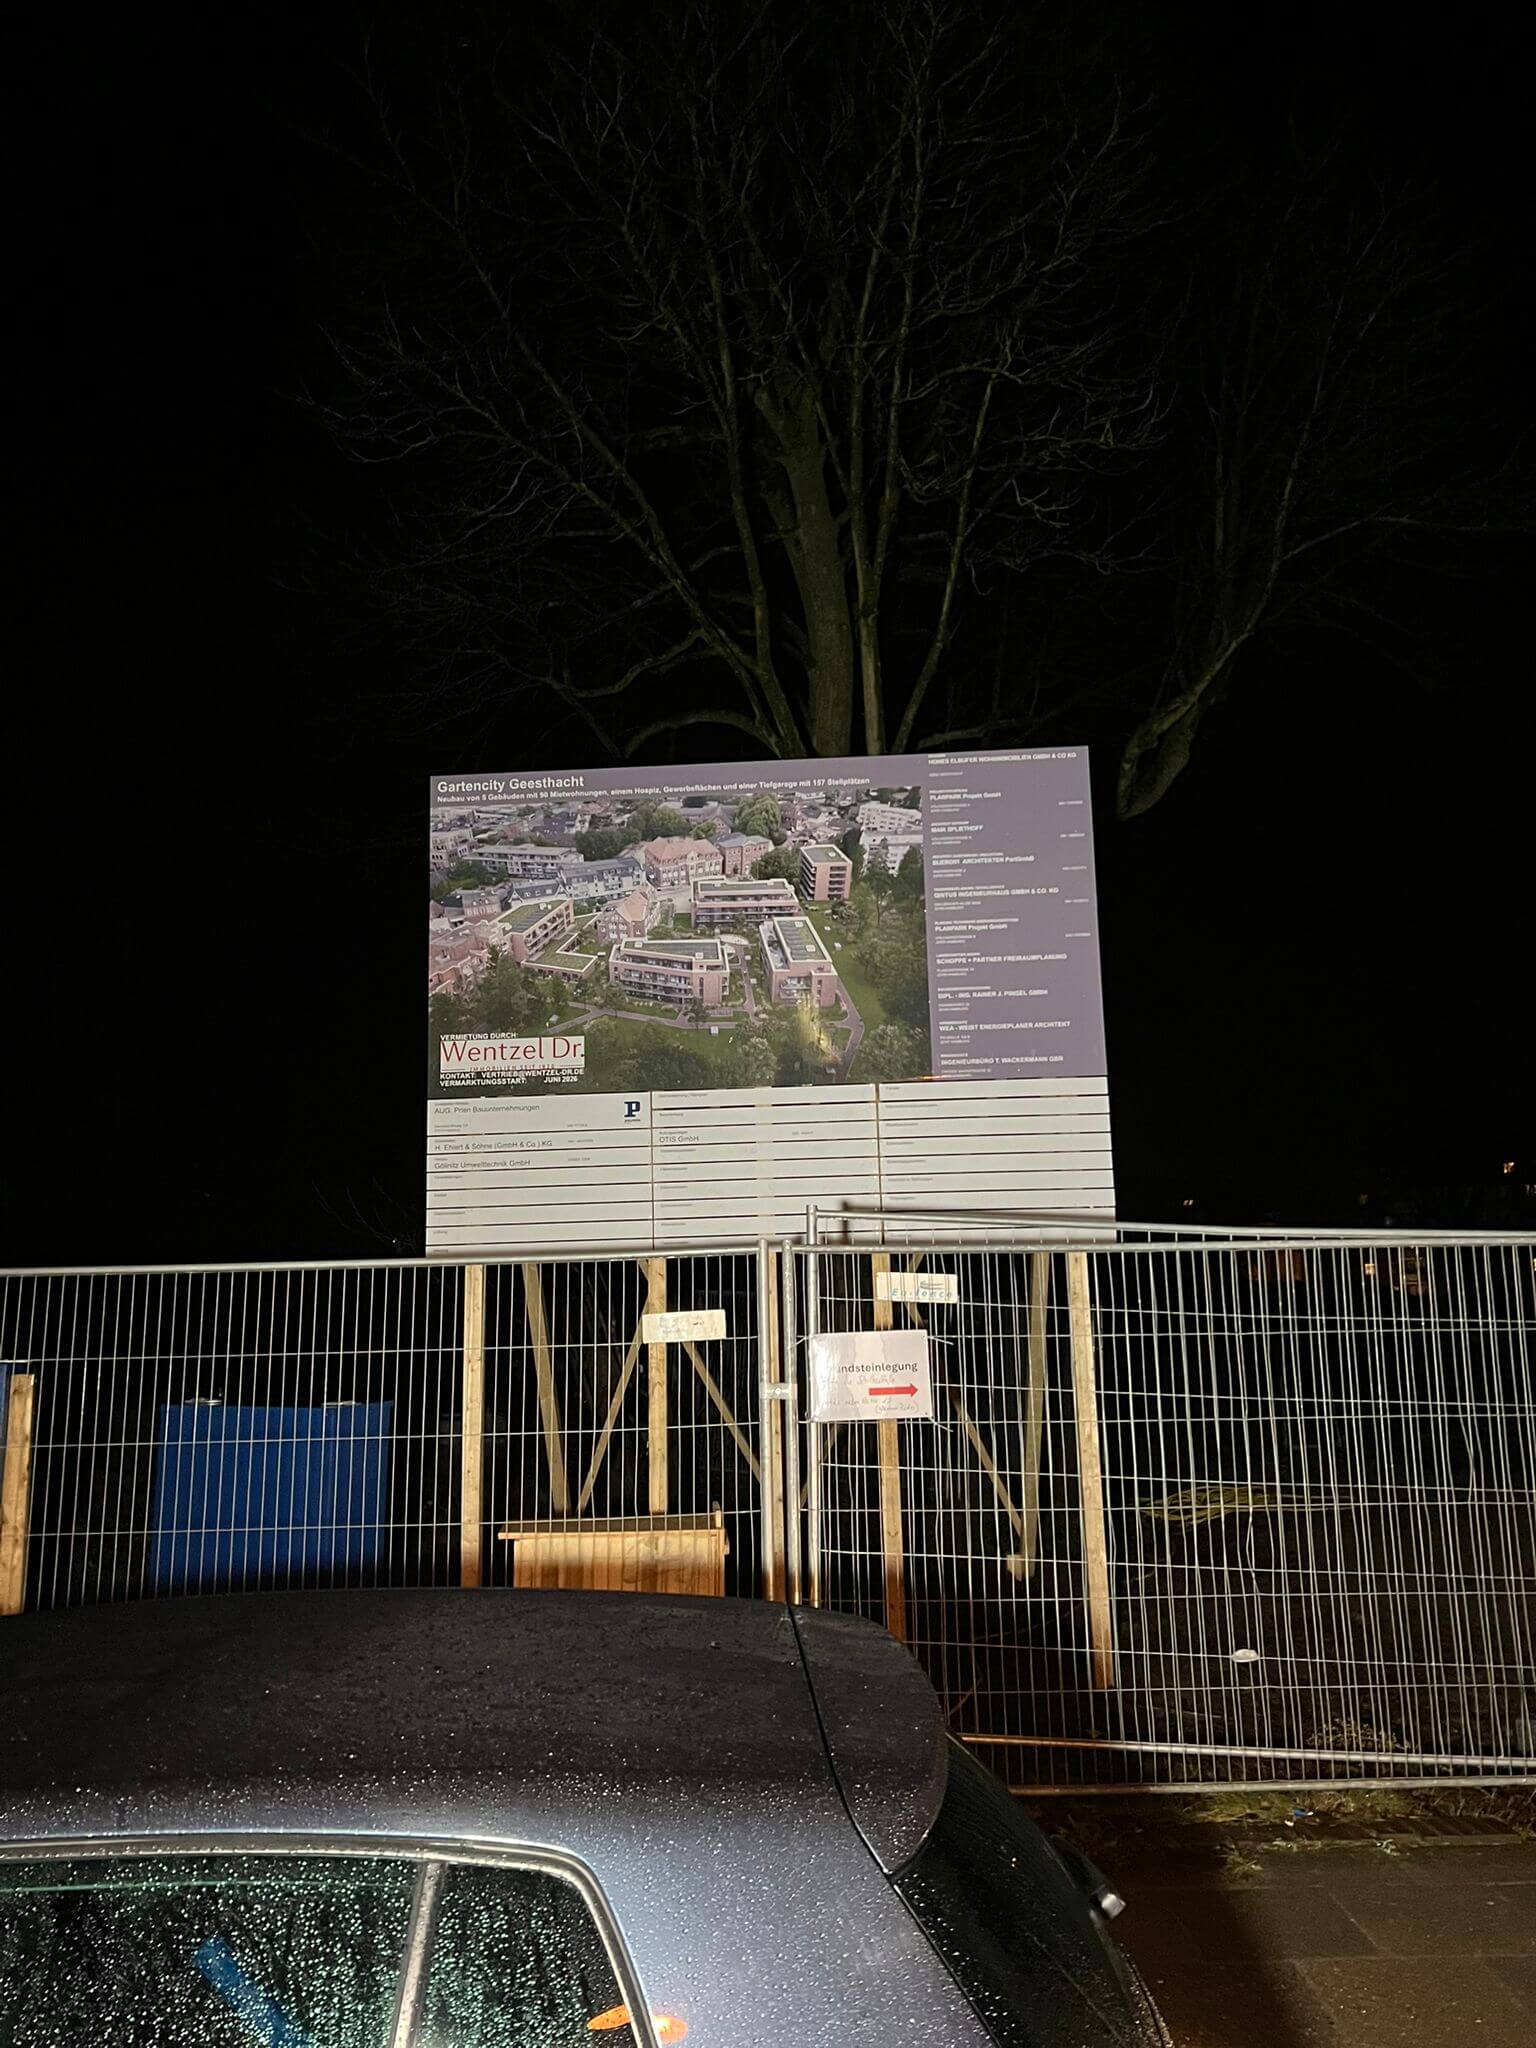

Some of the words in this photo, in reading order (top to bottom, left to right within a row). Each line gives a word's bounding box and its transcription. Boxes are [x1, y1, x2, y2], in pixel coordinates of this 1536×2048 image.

[437, 780, 505, 793] Gartencity
[509, 776, 584, 790] Geesthacht
[488, 793, 525, 801] Gebäuden
[550, 790, 609, 799] Mietwohnungen,
[610, 788, 632, 796] einem
[635, 786, 661, 795] Hospiz,
[663, 784, 722, 793] Gewerbeflächen
[723, 783, 737, 791] und
[739, 782, 758, 790] einer
[759, 780, 798, 791] Tiefgarage
[799, 779, 811, 787] mit
[827, 777, 870, 787] Stellplätzen
[440, 1033, 489, 1041] VERMIETUNG
[490, 1032, 518, 1040] DURCH:
[441, 1037, 545, 1063] Wentzel
[553, 1037, 585, 1059] Dr.
[440, 1077, 527, 1087] VERMARKTUNGSSTART:
[543, 1076, 561, 1084] JUNI
[624, 1101, 641, 1118] P
[509, 1159, 530, 1167] GmbH
